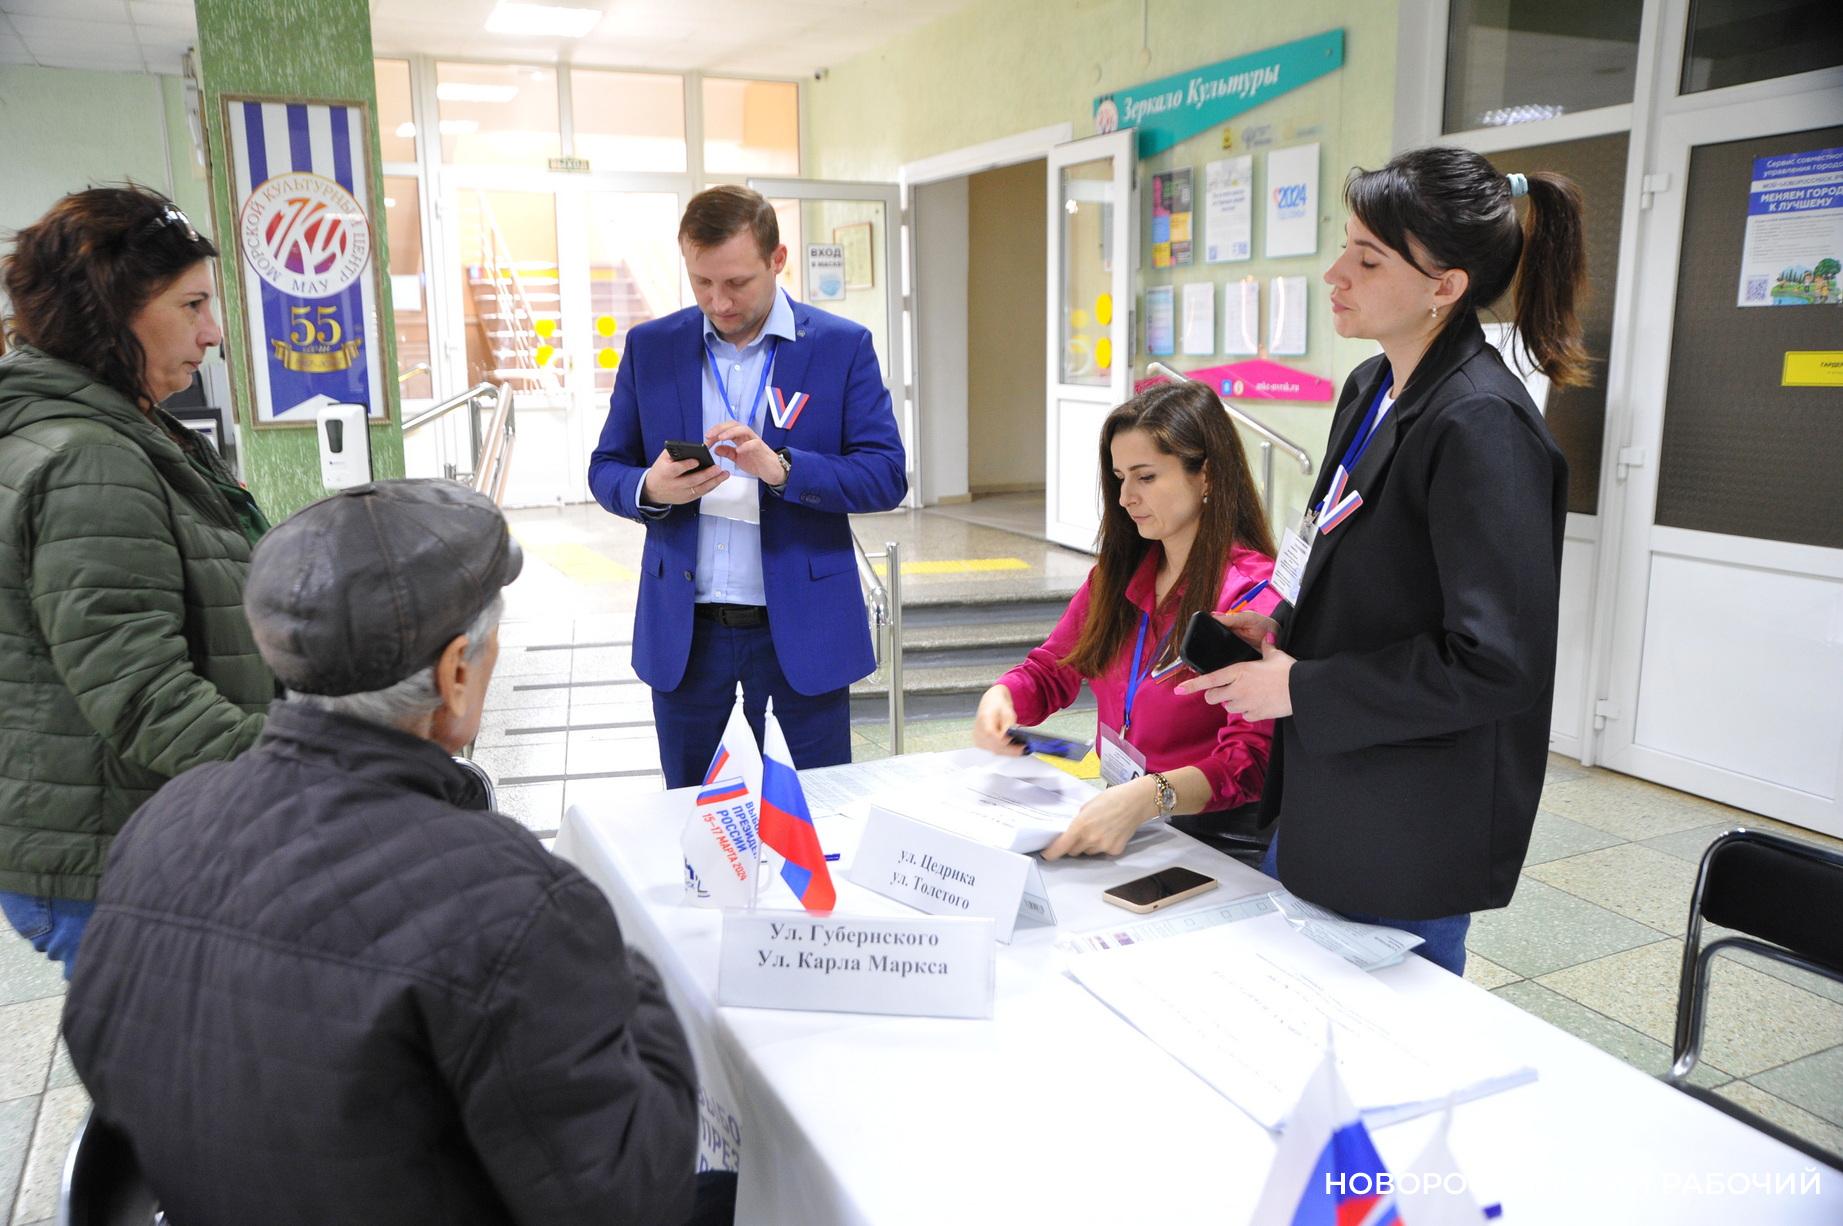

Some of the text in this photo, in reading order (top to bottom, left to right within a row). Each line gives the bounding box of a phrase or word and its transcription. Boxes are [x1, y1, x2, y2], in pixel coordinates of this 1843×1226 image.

[1122, 63, 1281, 123] Зеркало Культуры
[1278, 183, 1307, 209] 2024
[1760, 189, 1805, 203] МЕНЯЕМ
[1769, 197, 1833, 212] К ЛУЧШЕМУ
[246, 200, 282, 283] МОРСКОЙ
[339, 232, 366, 283] ЦЕНТР
[811, 248, 842, 258] ВХОД
[292, 278, 329, 294] МАУ
[290, 305, 342, 346] 55
[716, 809, 747, 852] РОССИИ
[719, 835, 739, 864] МАРТА
[732, 862, 749, 881] 2024
[898, 850, 976, 887] ул. Цедрика
[889, 871, 970, 910] ул. Толстого
[770, 922, 940, 949] Ул. Губернского
[758, 950, 949, 978] Ул. Карла Маркса
